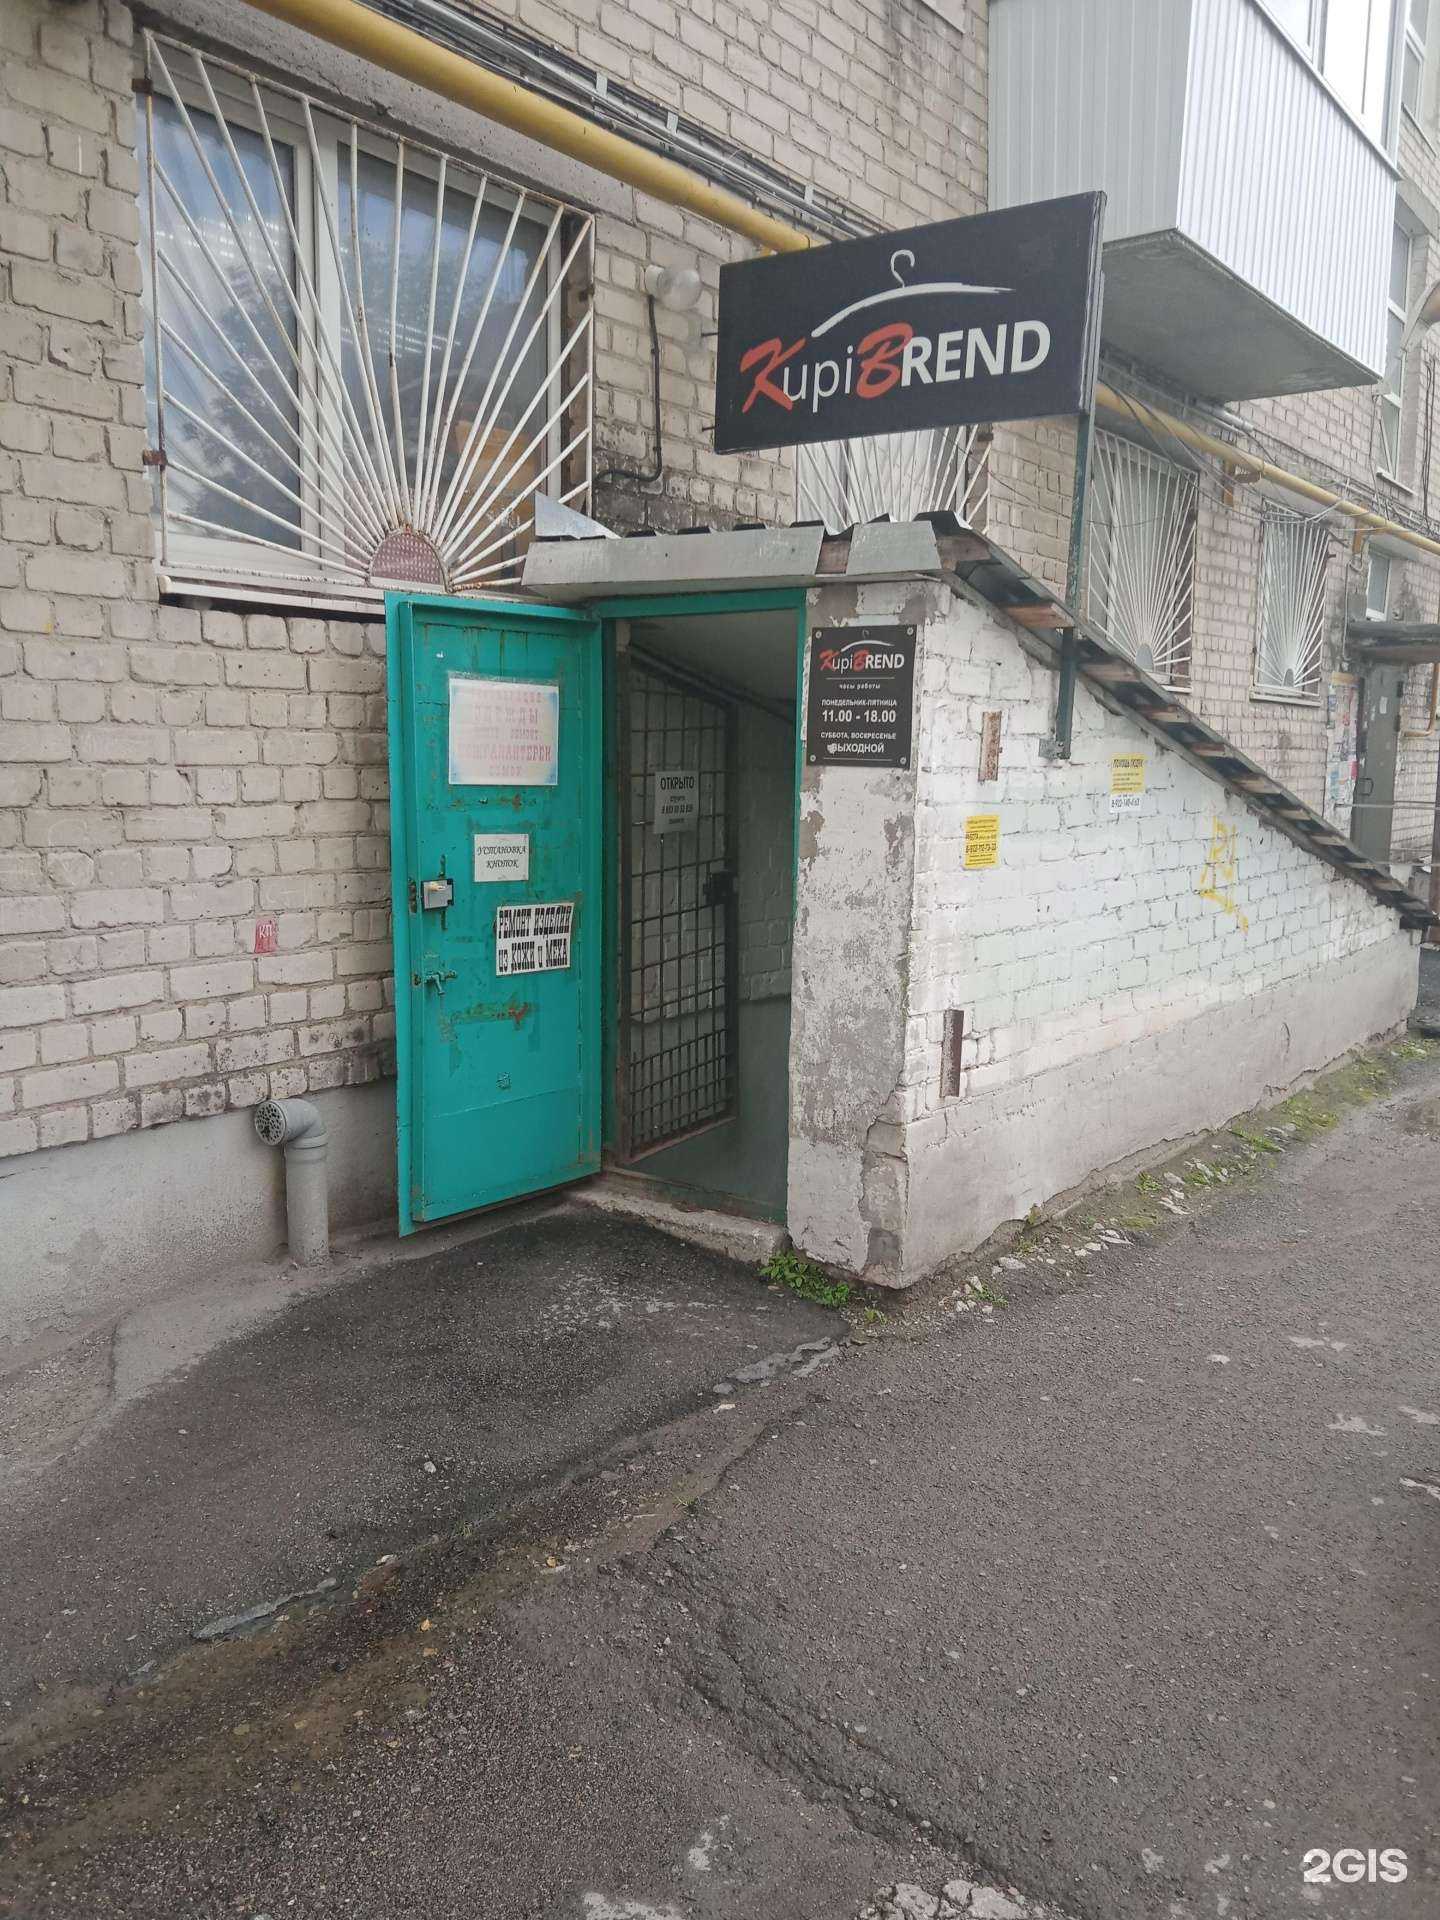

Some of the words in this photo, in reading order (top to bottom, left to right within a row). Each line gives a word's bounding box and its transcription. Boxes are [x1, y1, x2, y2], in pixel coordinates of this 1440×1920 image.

[739, 320, 1051, 413] KupiBREND
[819, 649, 905, 674] KupiBREND
[822, 710, 853, 722] 11.00
[863, 709, 896, 722] 18.00
[851, 732, 897, 740] ВОСКРЕСЕНЬЕ
[832, 743, 885, 754] ВЫХОДНОЙ
[660, 776, 695, 790] ОТКРЫТО
[477, 845, 527, 856] УСТАНОВКА
[486, 859, 519, 869] КНОПОК
[498, 908, 532, 939] РЕМОНТ
[534, 905, 572, 938] ИЗДЕЛИЙ
[511, 941, 535, 972] КОЖИ
[546, 938, 568, 968] МЕХА
